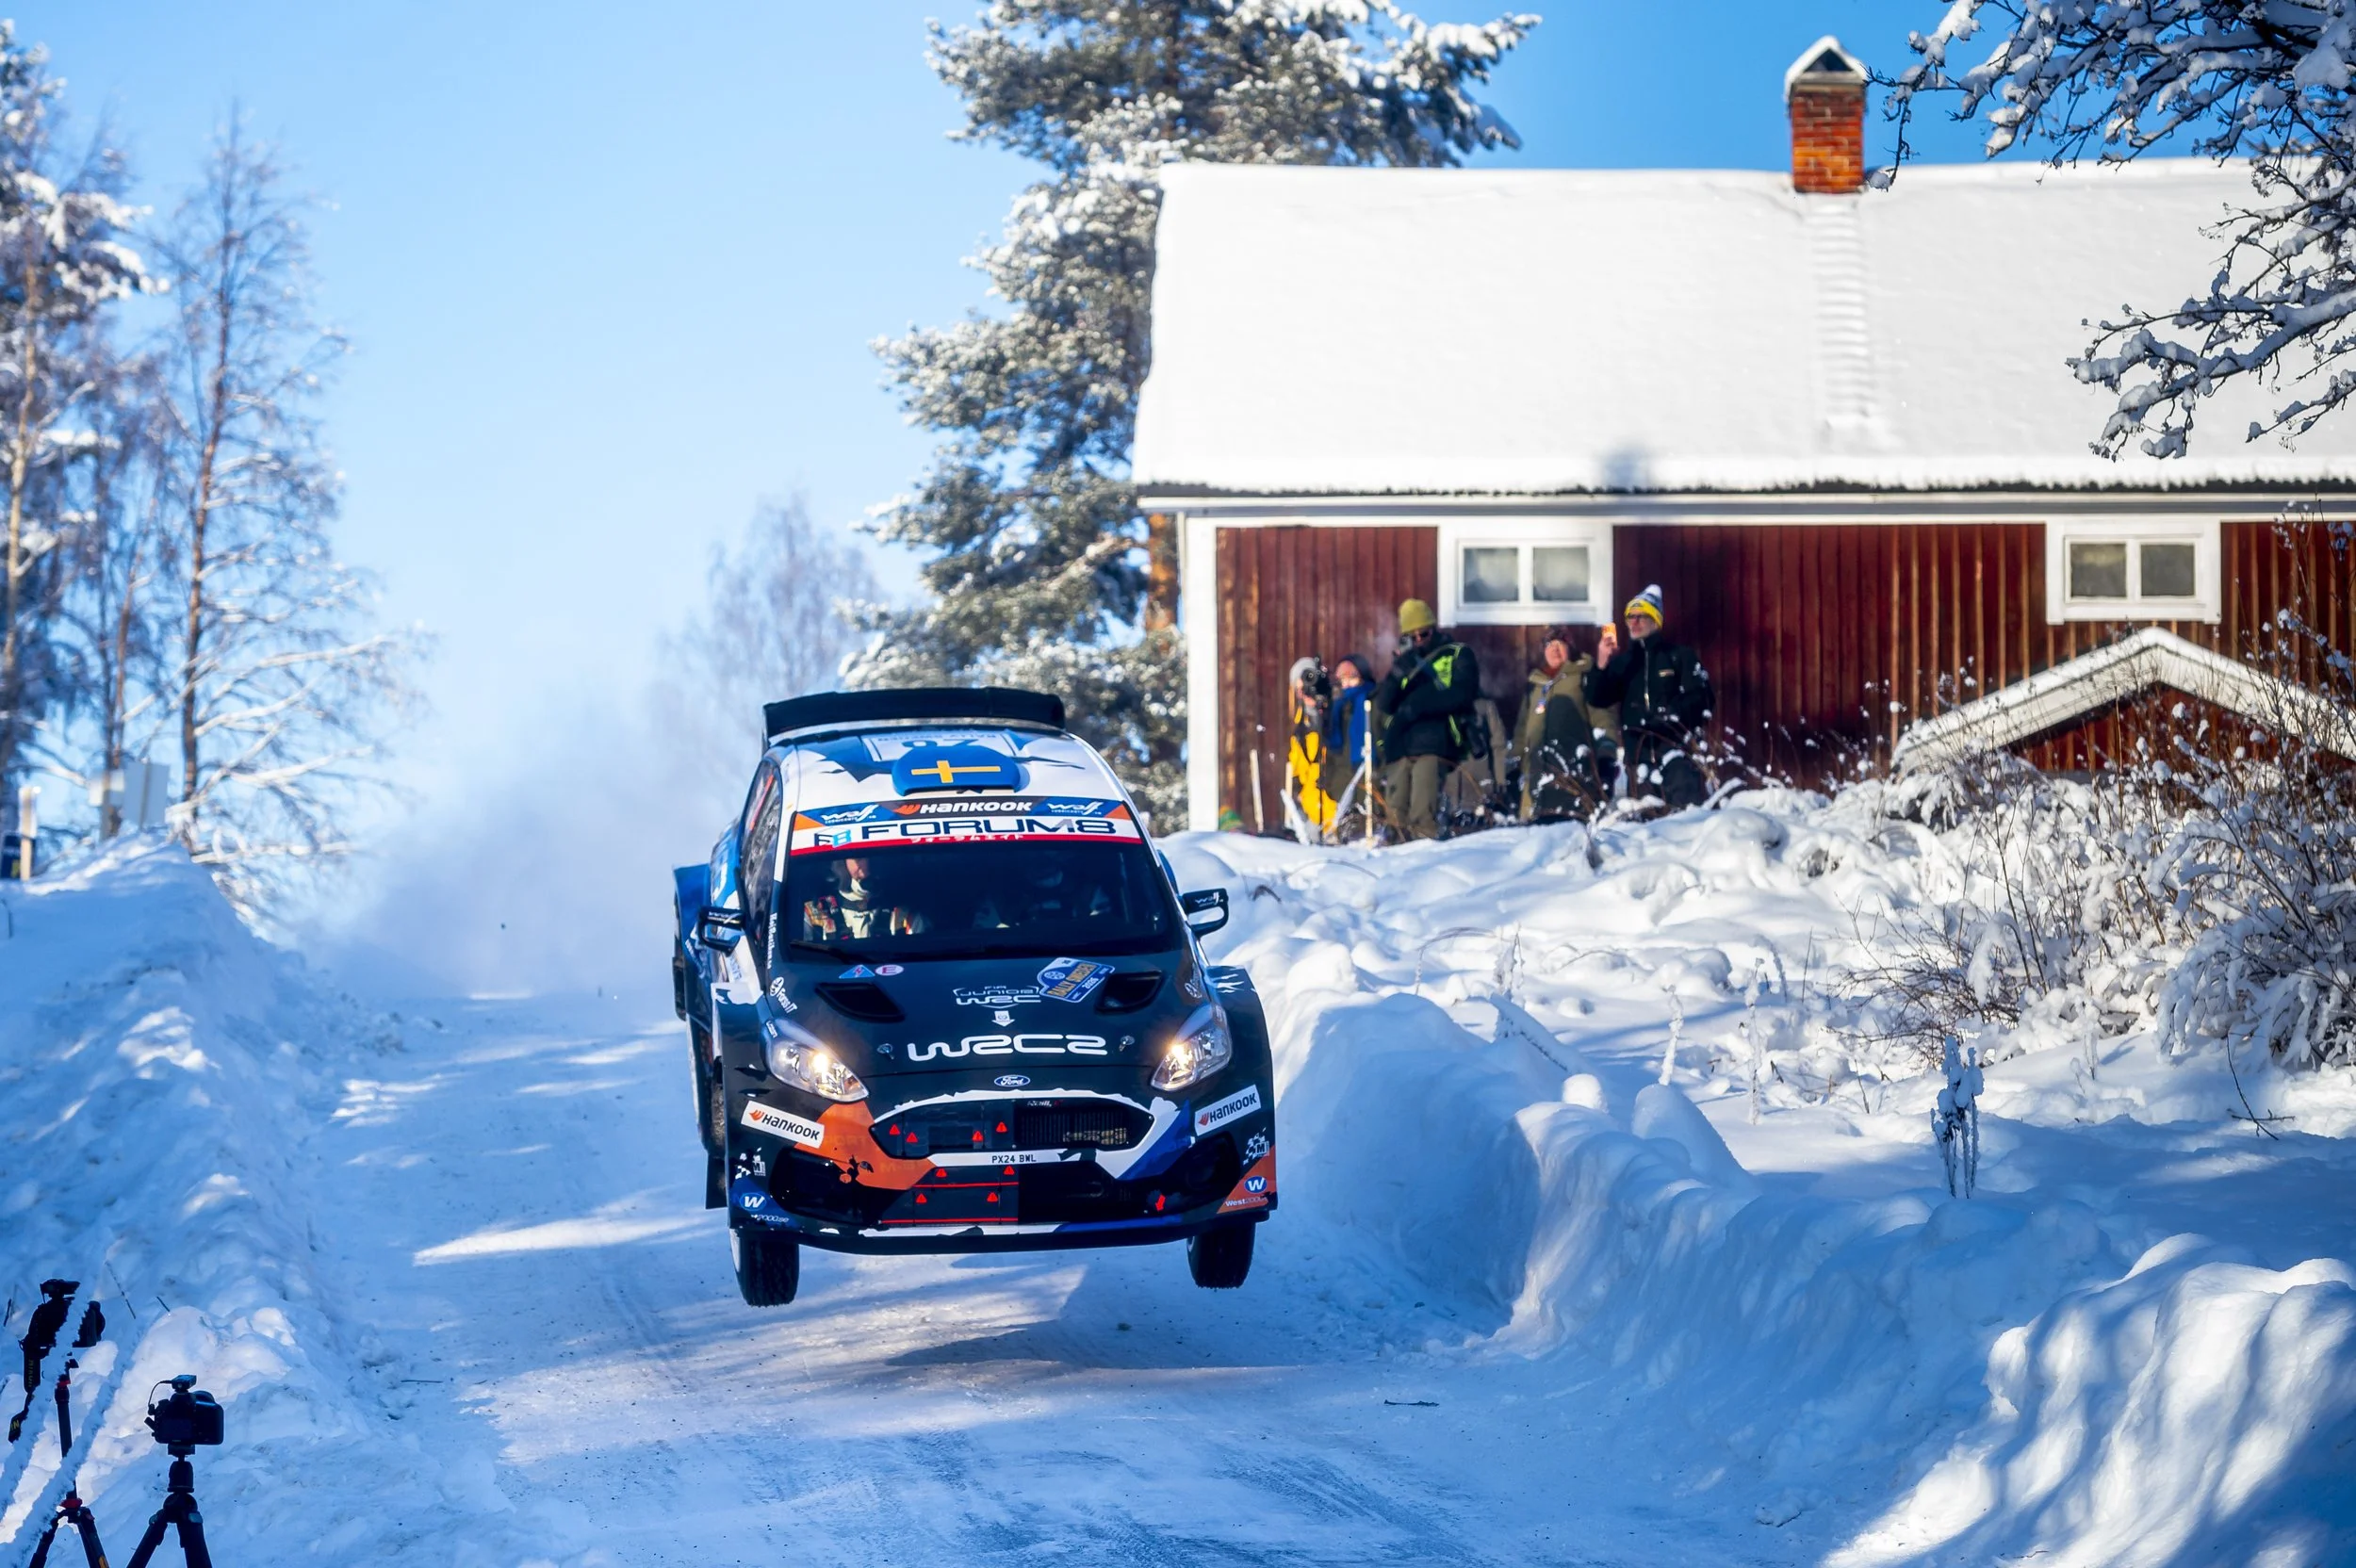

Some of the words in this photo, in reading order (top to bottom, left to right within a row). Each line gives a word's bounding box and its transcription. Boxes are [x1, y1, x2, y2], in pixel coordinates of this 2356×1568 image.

[861, 818, 1117, 840] FORUM8
[959, 988, 1034, 997] JUNIOR
[956, 995, 1041, 1005] WRC
[907, 1034, 1108, 1062] WRC2
[1000, 1075, 1024, 1086] Ford
[991, 1155, 1016, 1164] PX24
[1019, 1153, 1037, 1163] BWL
[1247, 1176, 1266, 1192] W
[744, 1195, 766, 1208] W
